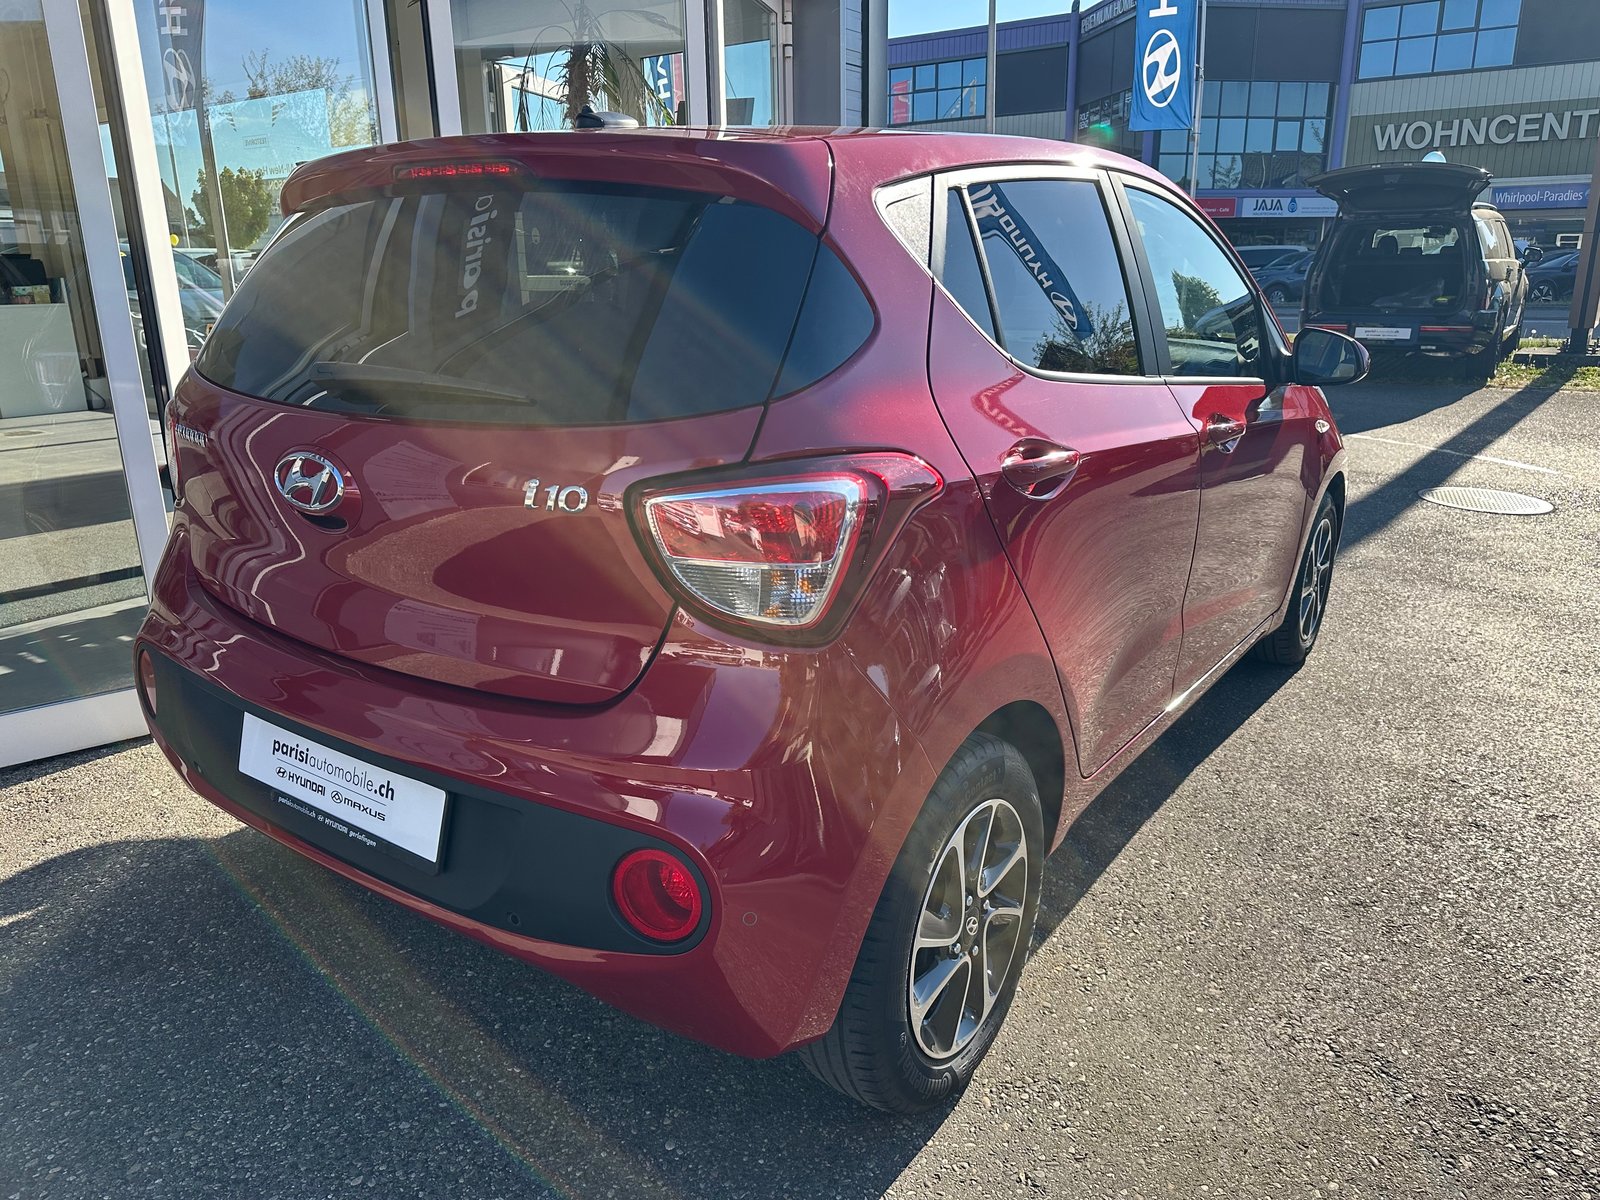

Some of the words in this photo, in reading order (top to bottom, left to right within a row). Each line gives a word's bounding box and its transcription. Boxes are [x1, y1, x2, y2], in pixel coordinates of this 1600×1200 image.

[1374, 108, 1600, 151] WOHNCENT
[1253, 199, 1283, 211] JAJA
[1495, 190, 1583, 205] Whirlpool-Paradies
[522, 479, 588, 512] i10
[272, 738, 395, 801] parisiautomobile.ch
[288, 771, 326, 797] HYUNDAI
[343, 797, 386, 822] MAXUS
[324, 818, 348, 834] HYUNDAI
